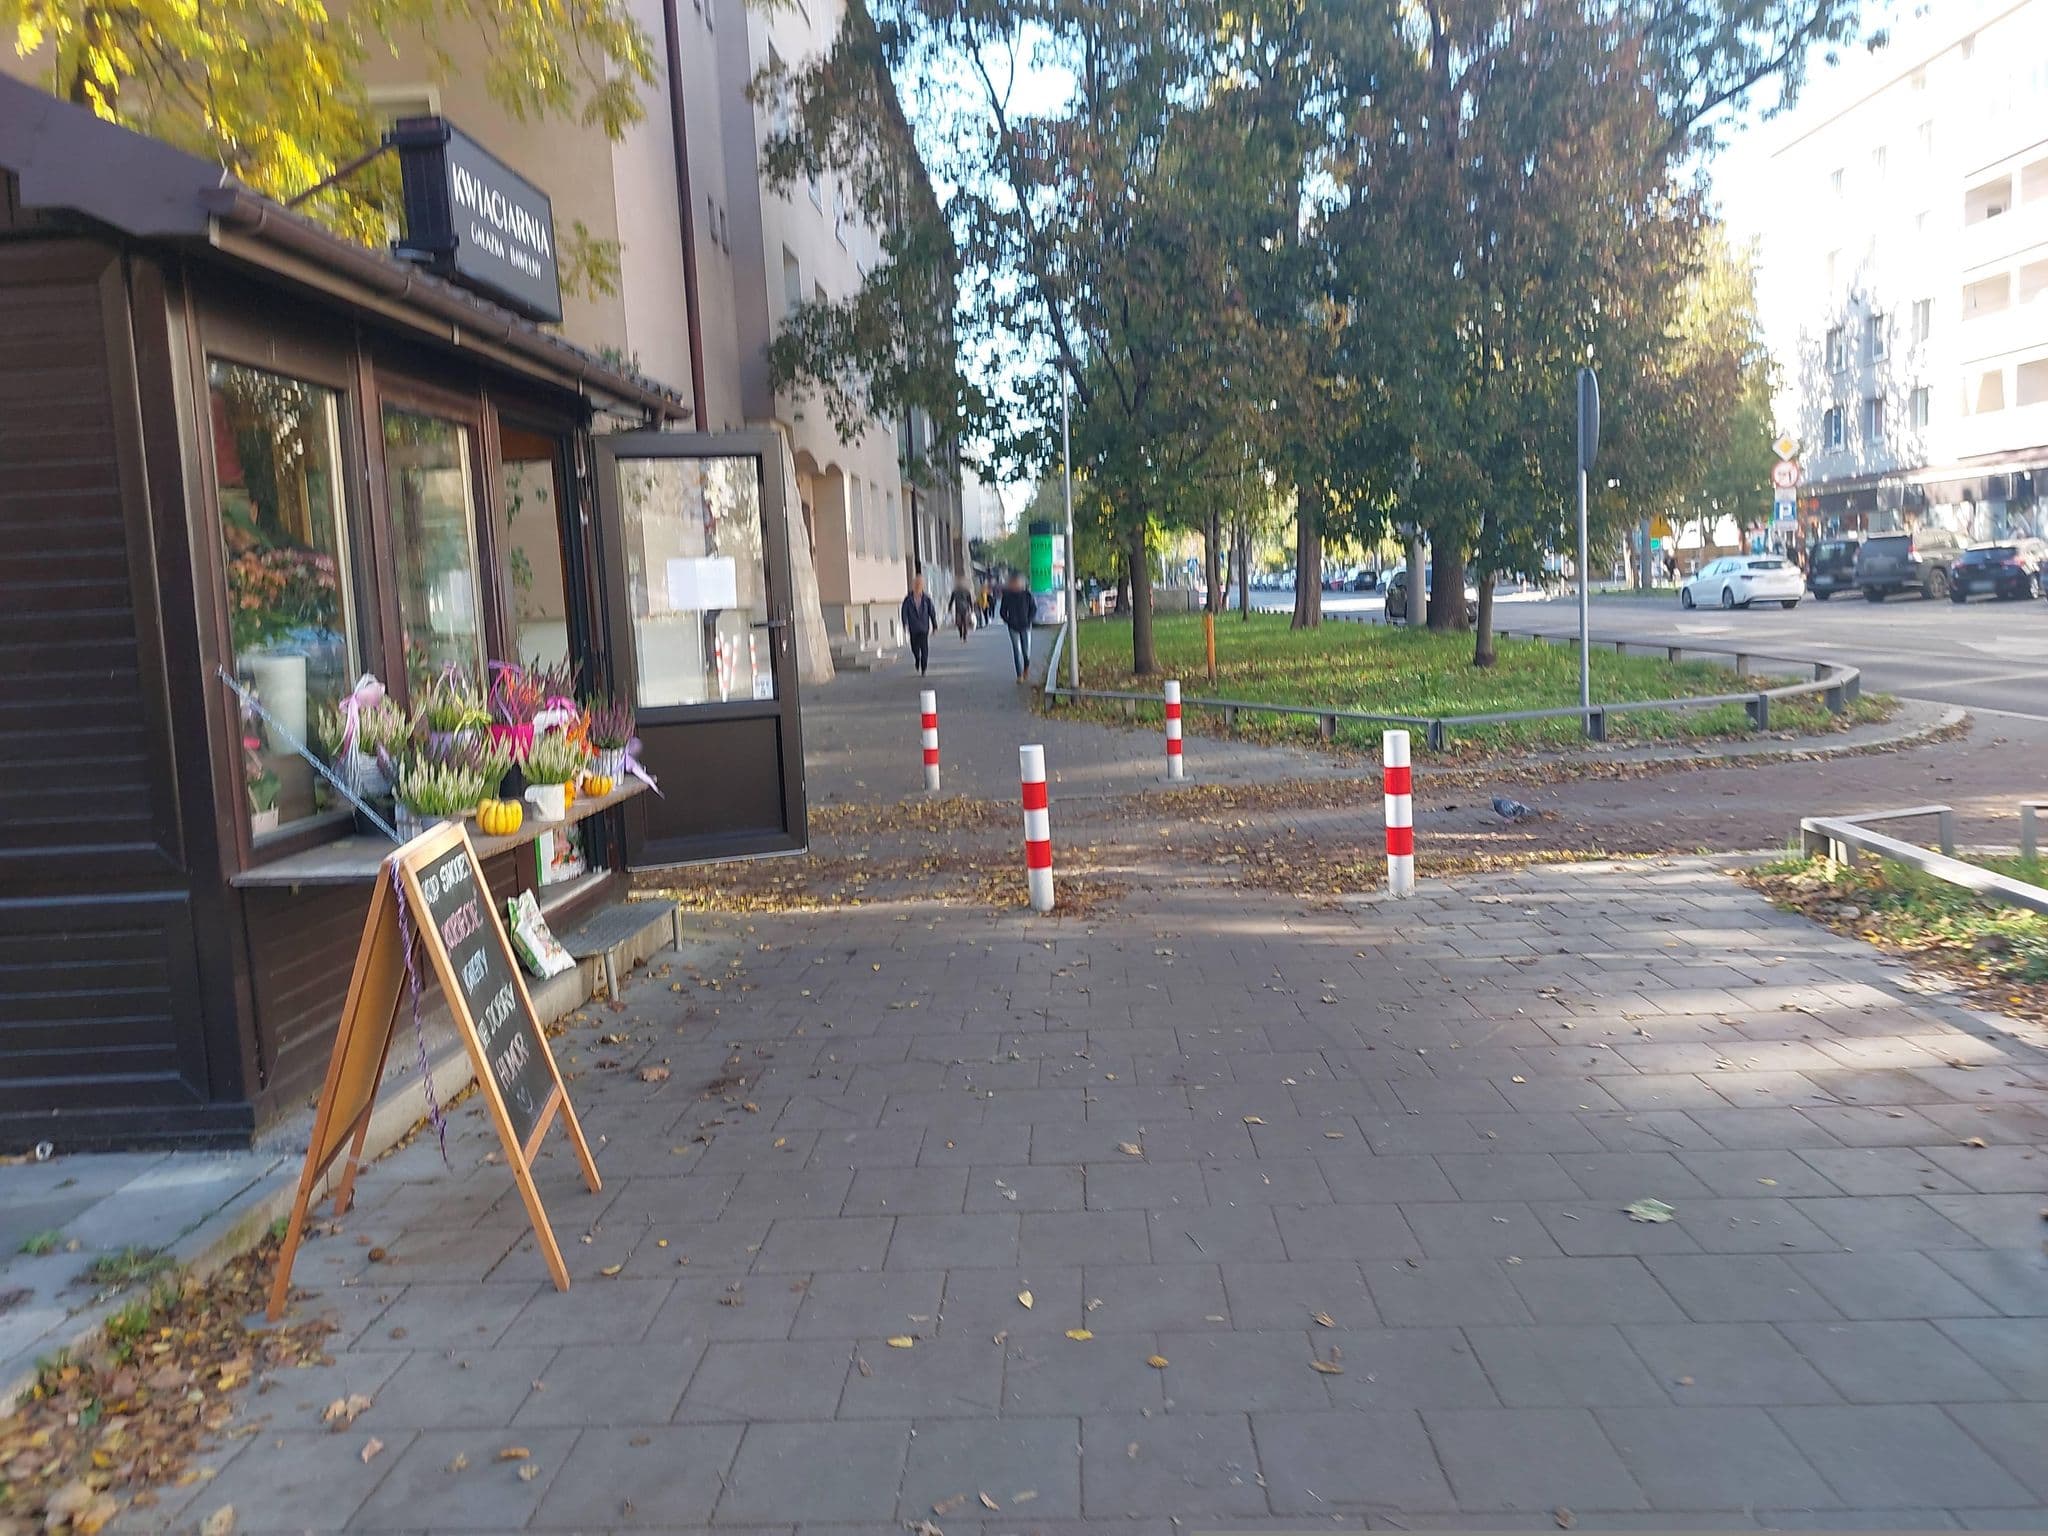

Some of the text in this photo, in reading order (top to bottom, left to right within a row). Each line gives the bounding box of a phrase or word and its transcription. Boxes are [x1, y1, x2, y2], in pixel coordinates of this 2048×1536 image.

[452, 161, 550, 260] KWIACIARNIA
[485, 980, 516, 1036] DOBRY
[495, 1031, 530, 1092] HUMOR
